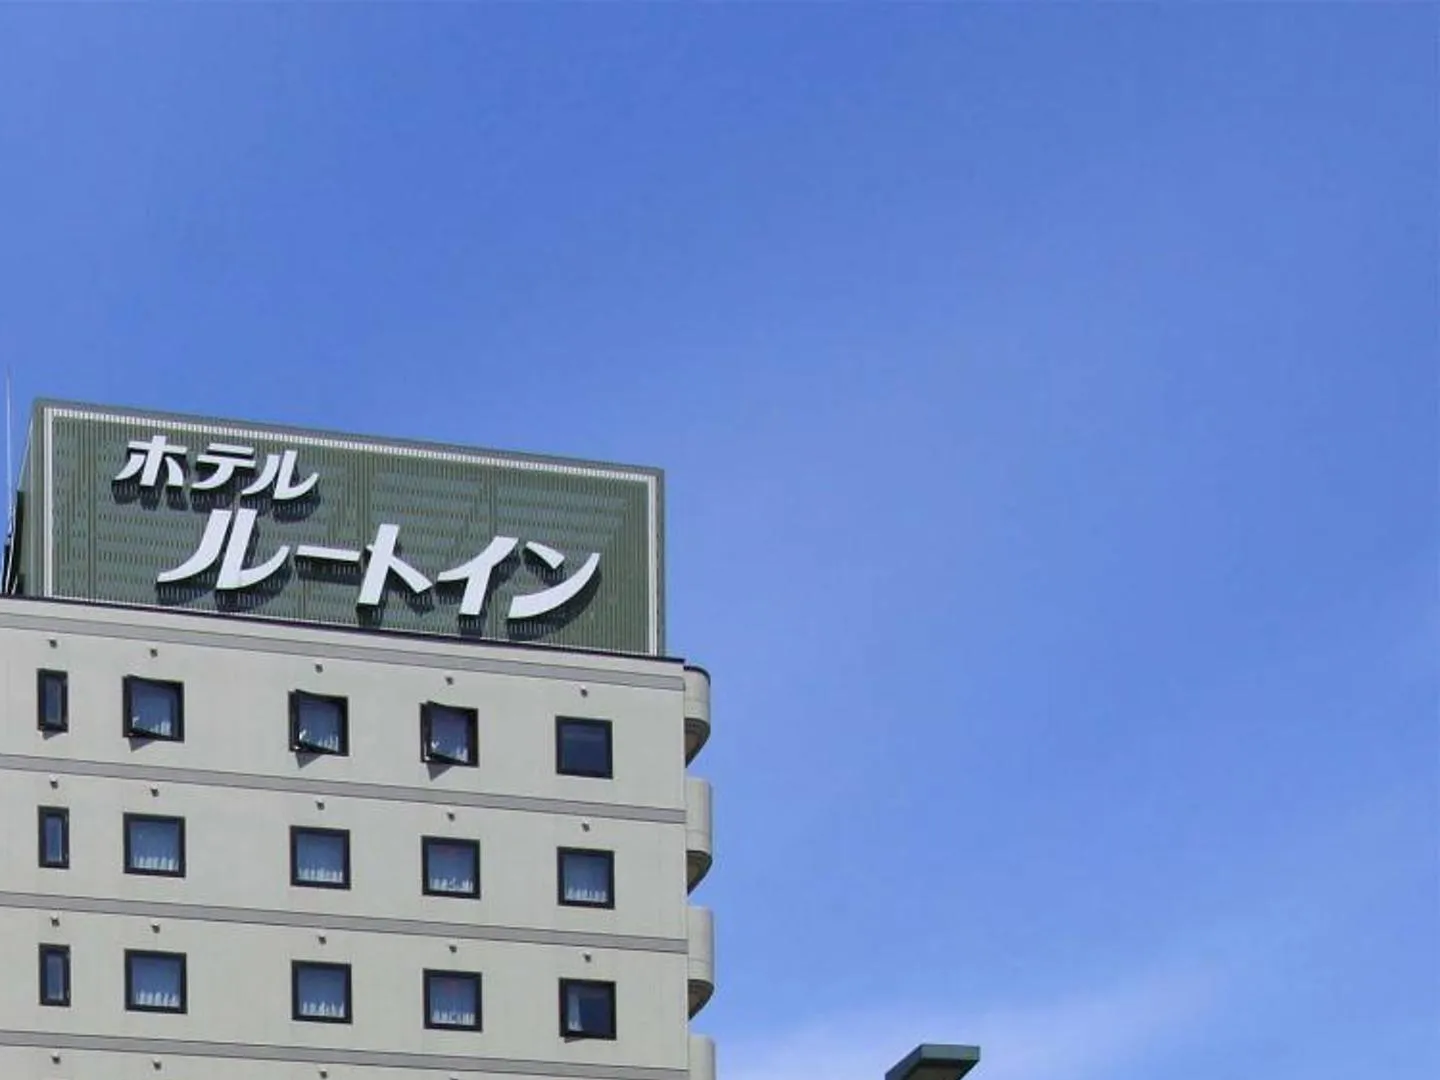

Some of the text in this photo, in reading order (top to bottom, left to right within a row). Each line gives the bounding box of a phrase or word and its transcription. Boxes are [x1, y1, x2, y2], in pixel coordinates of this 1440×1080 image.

[112, 435, 319, 499] ホテル
[156, 508, 601, 619] ルートイン
